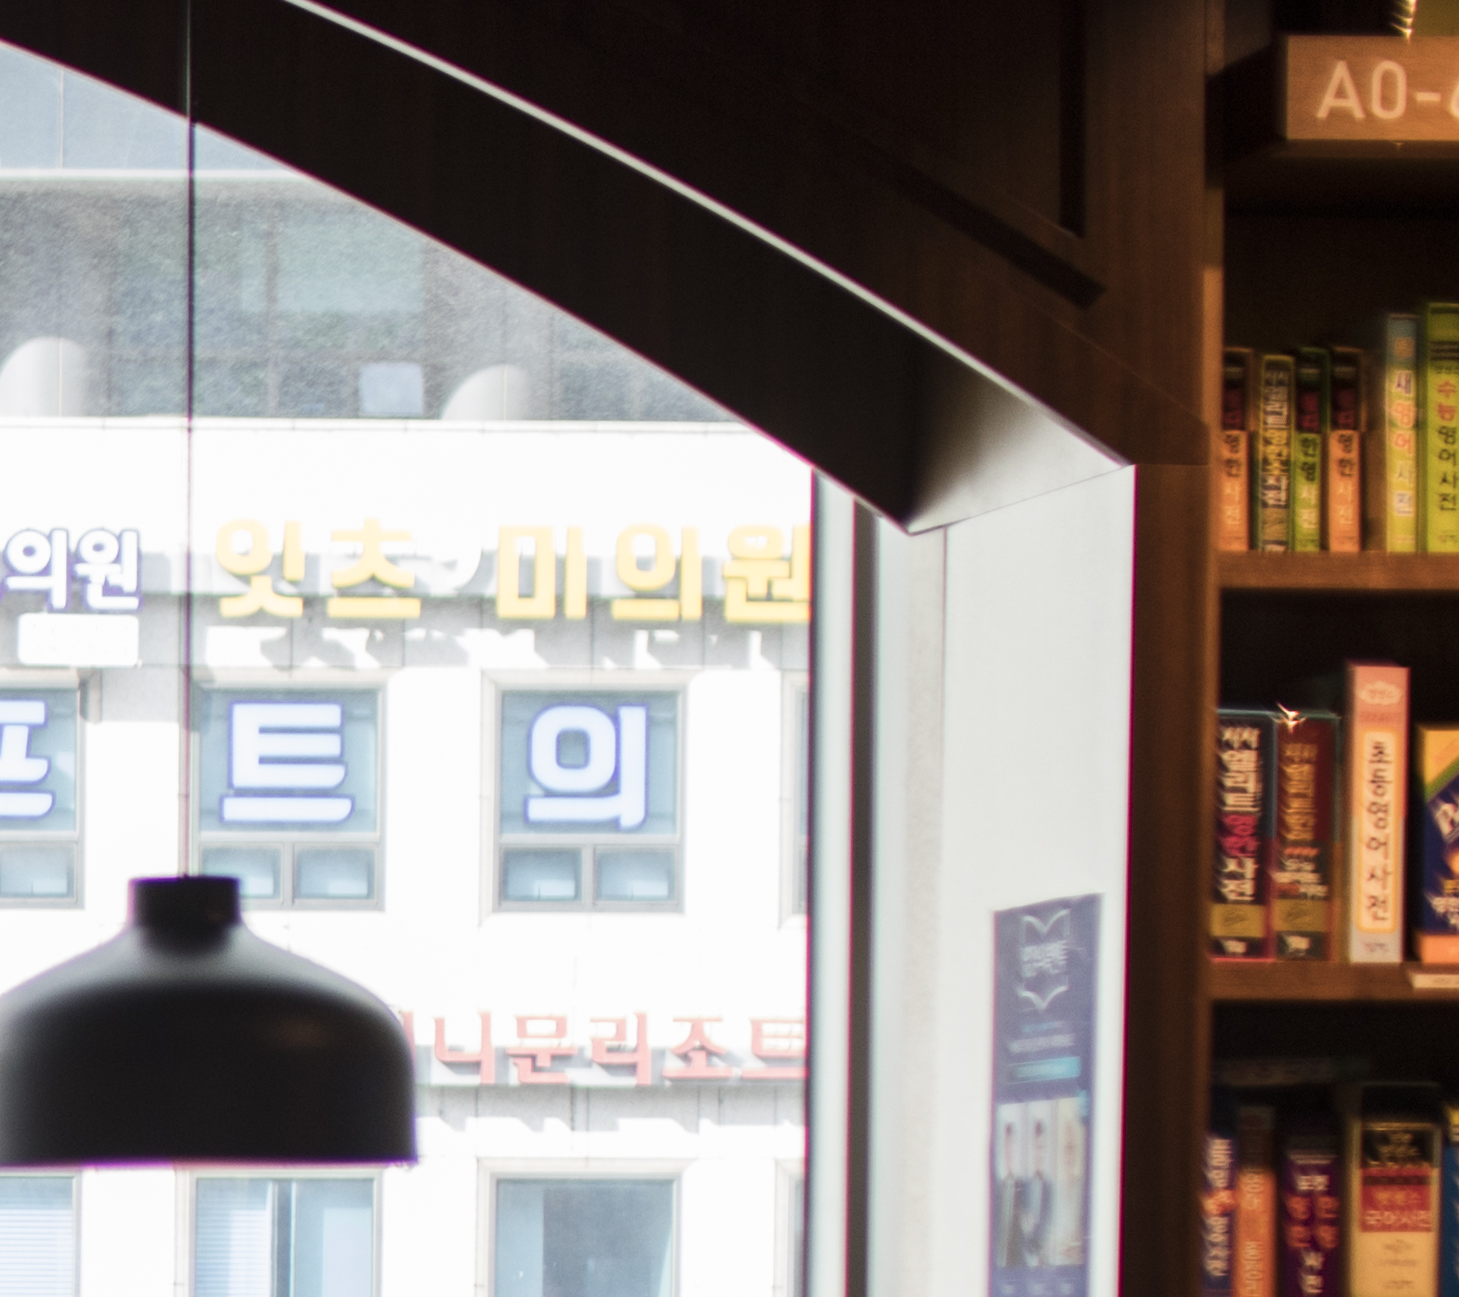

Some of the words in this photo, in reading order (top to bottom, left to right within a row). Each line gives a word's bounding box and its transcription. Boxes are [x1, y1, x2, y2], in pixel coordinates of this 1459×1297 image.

[1316, 60, 1459, 120] A0-
[215, 517, 421, 619] 잇츠
[496, 523, 811, 622] 미의원
[401, 1009, 806, 1085] 니문리조트
